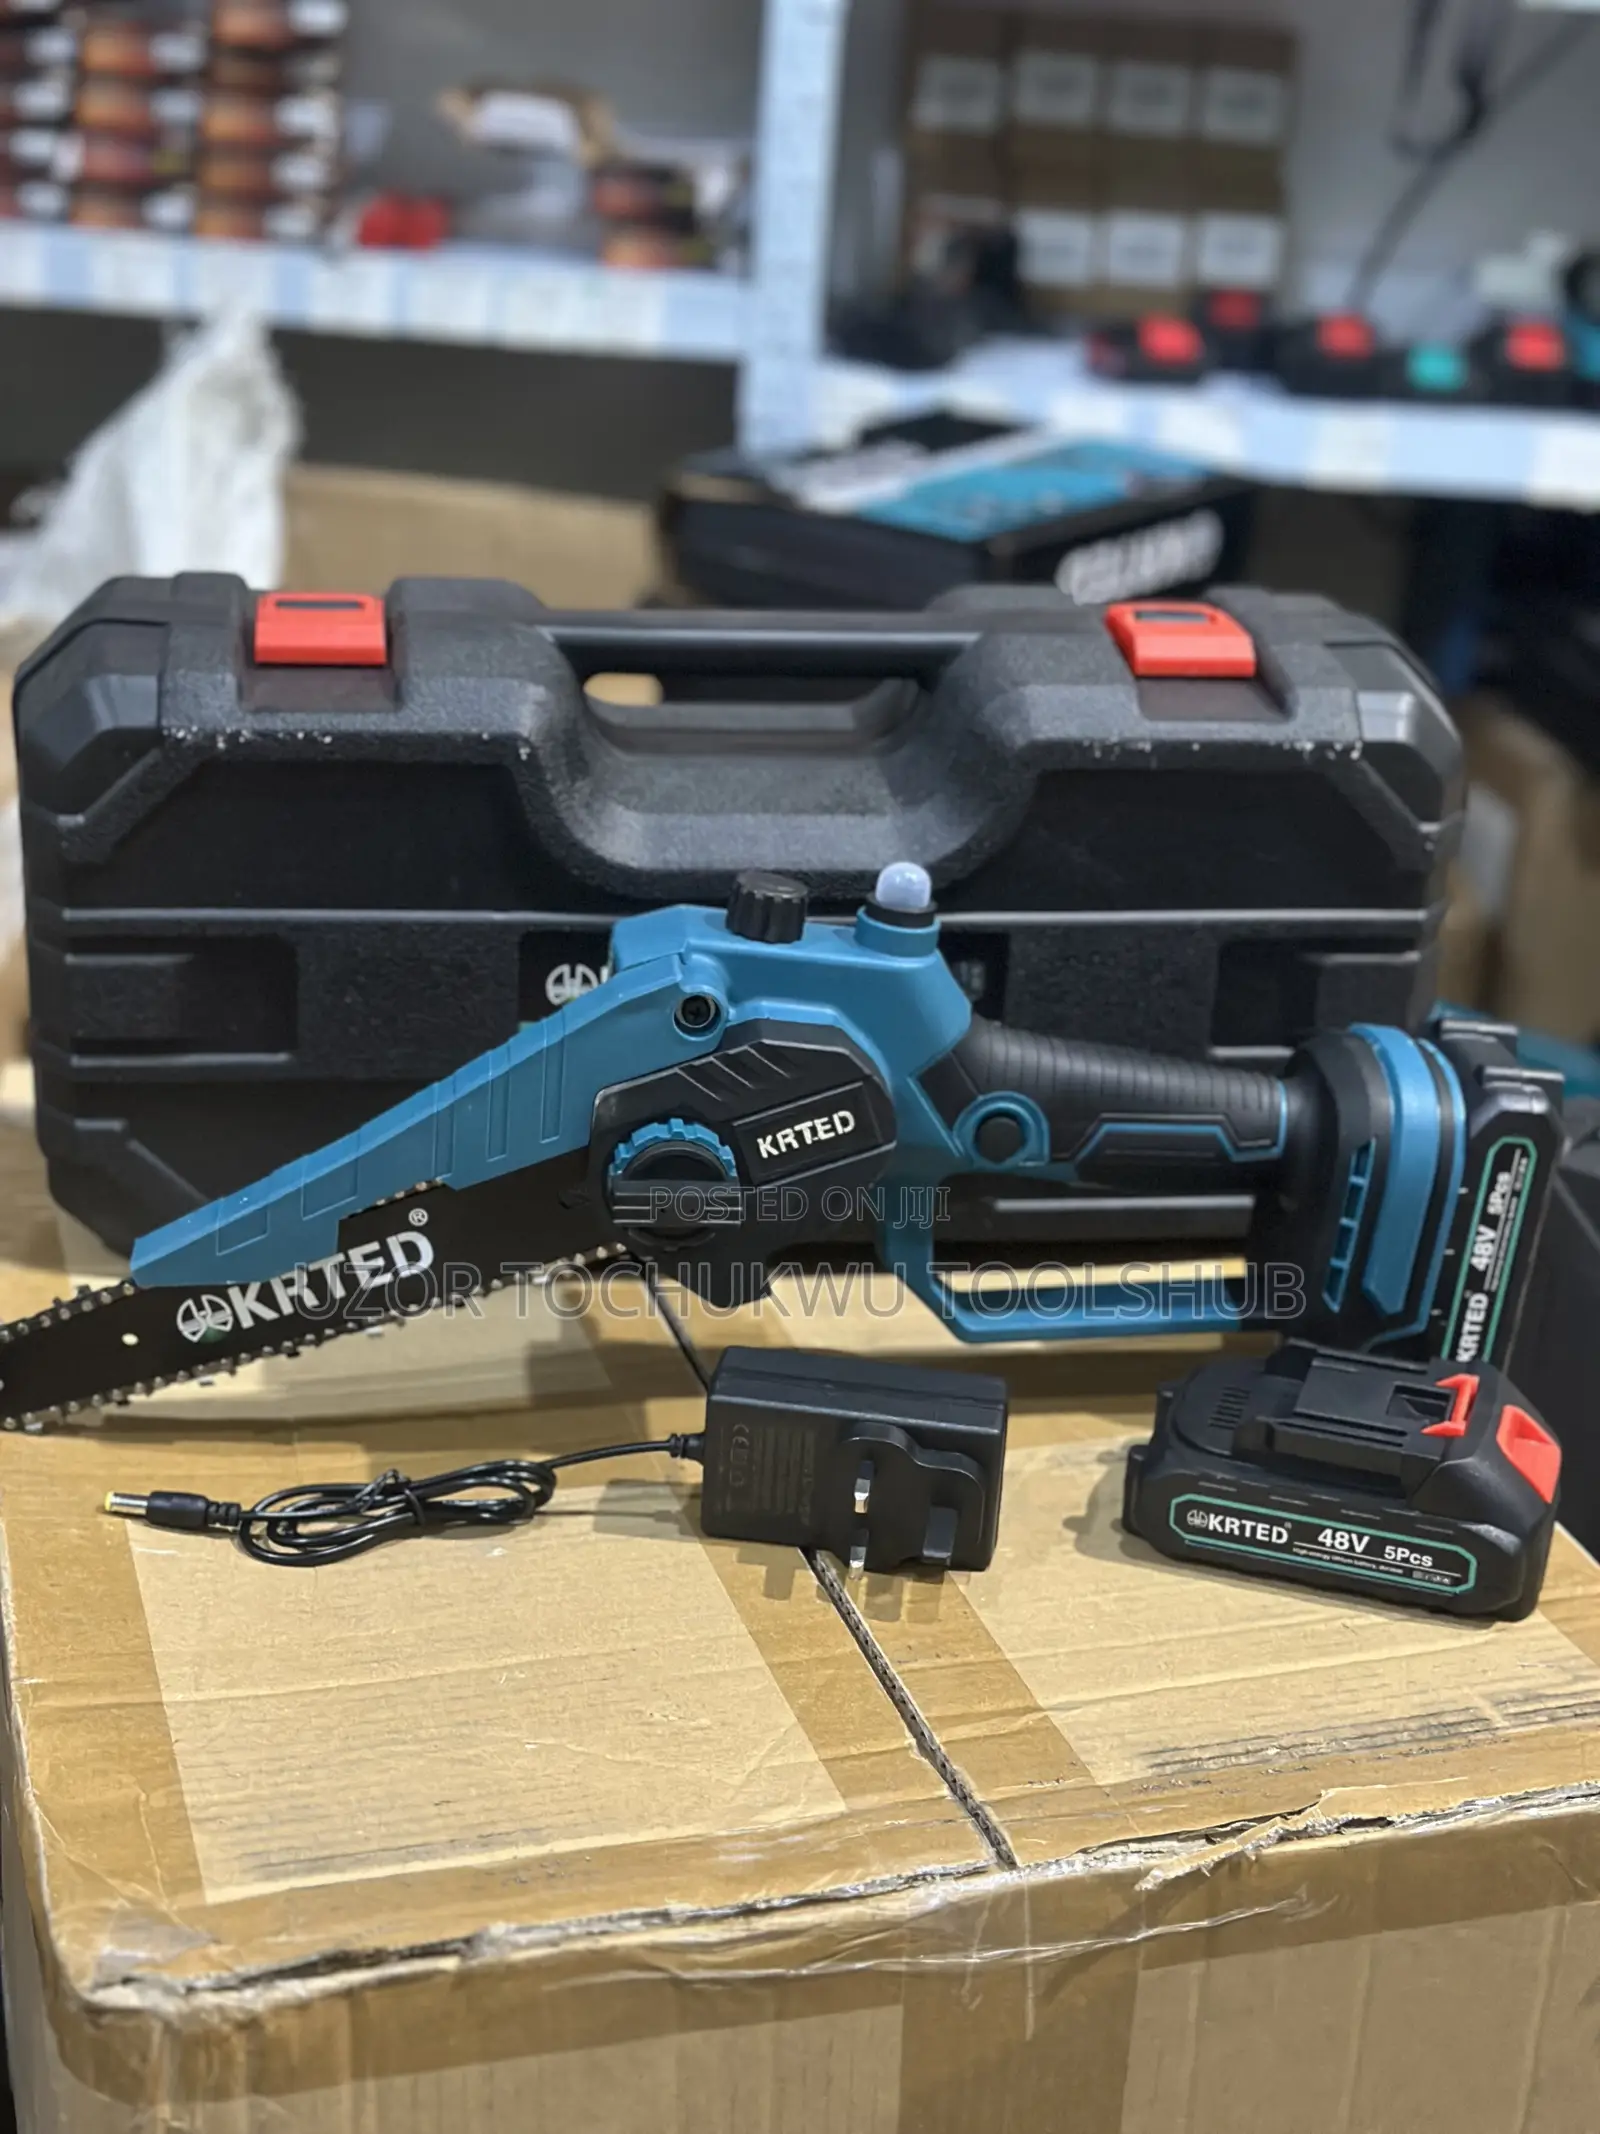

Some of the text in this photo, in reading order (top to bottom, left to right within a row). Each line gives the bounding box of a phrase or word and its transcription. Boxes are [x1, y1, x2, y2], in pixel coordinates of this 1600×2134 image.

[757, 1109, 856, 1159] KRTED
[1470, 1223, 1497, 1272] 48V
[227, 1231, 434, 1329] KRTED
[1455, 1293, 1489, 1362] KRTED
[1207, 1513, 1433, 1567] KRTED 48V 5Pcs
